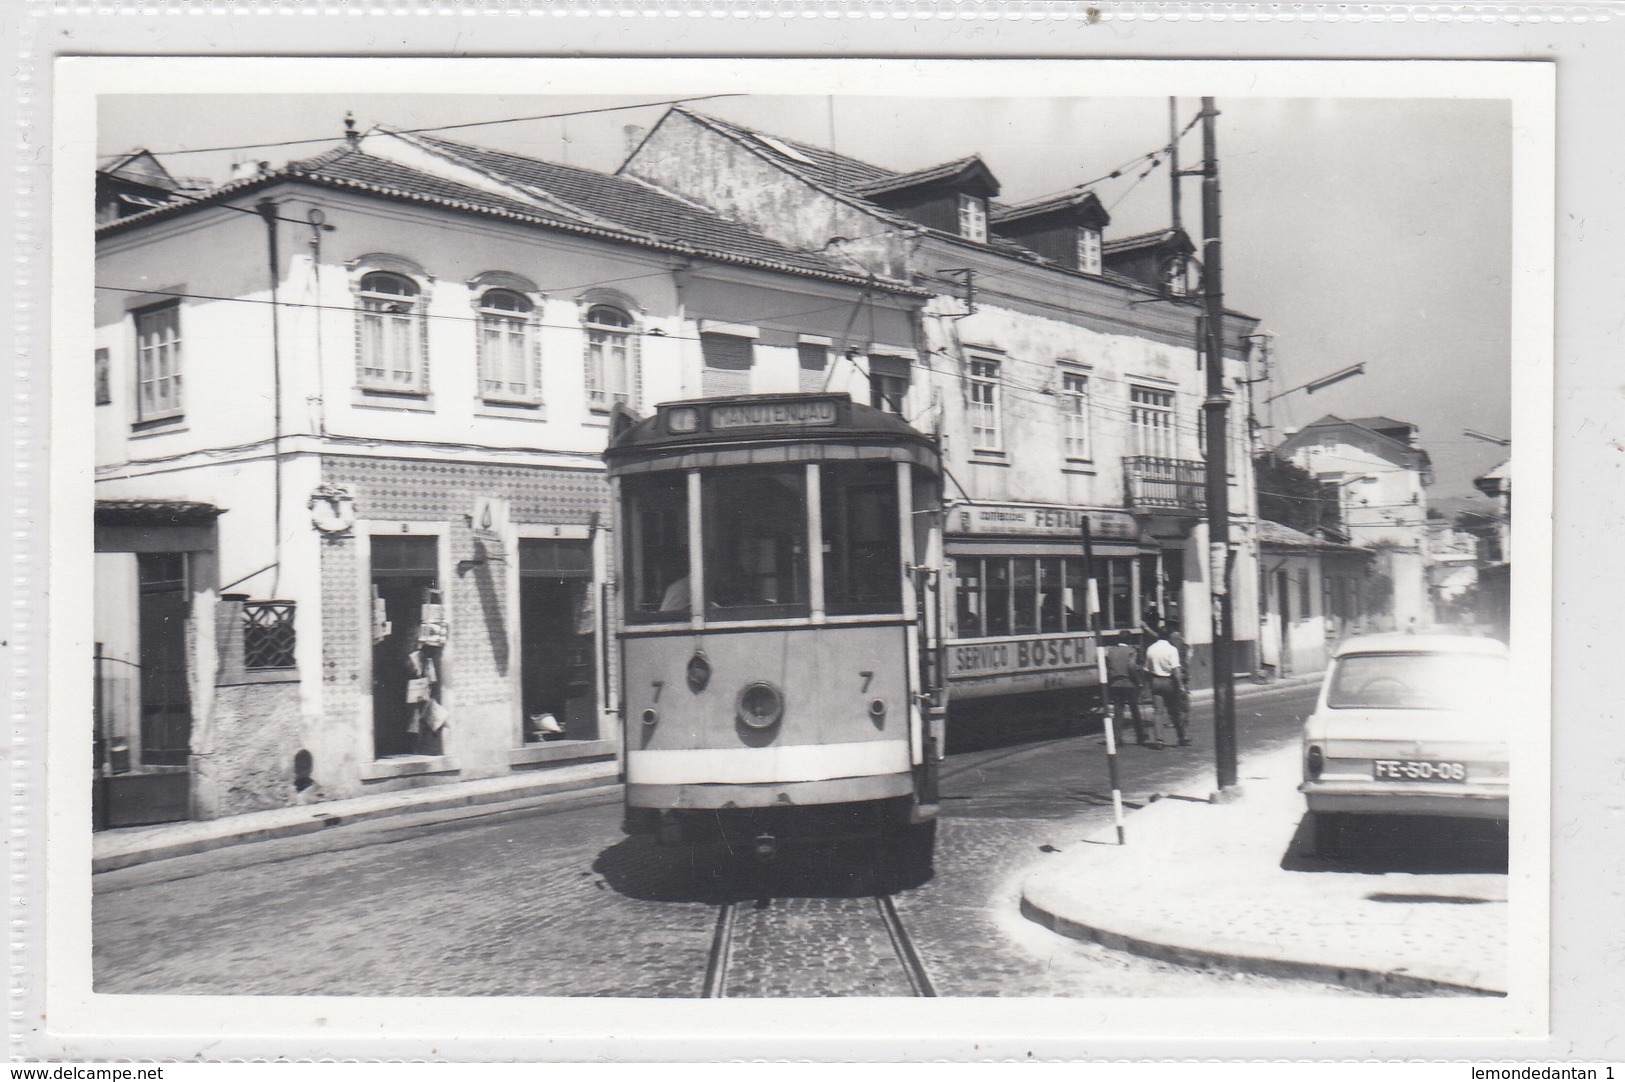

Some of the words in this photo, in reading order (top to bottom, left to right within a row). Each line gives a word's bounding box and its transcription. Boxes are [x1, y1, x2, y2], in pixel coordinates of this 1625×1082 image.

[1019, 639, 1086, 668] BOSCH
[651, 681, 664, 703] 7
[859, 671, 874, 693] 7
